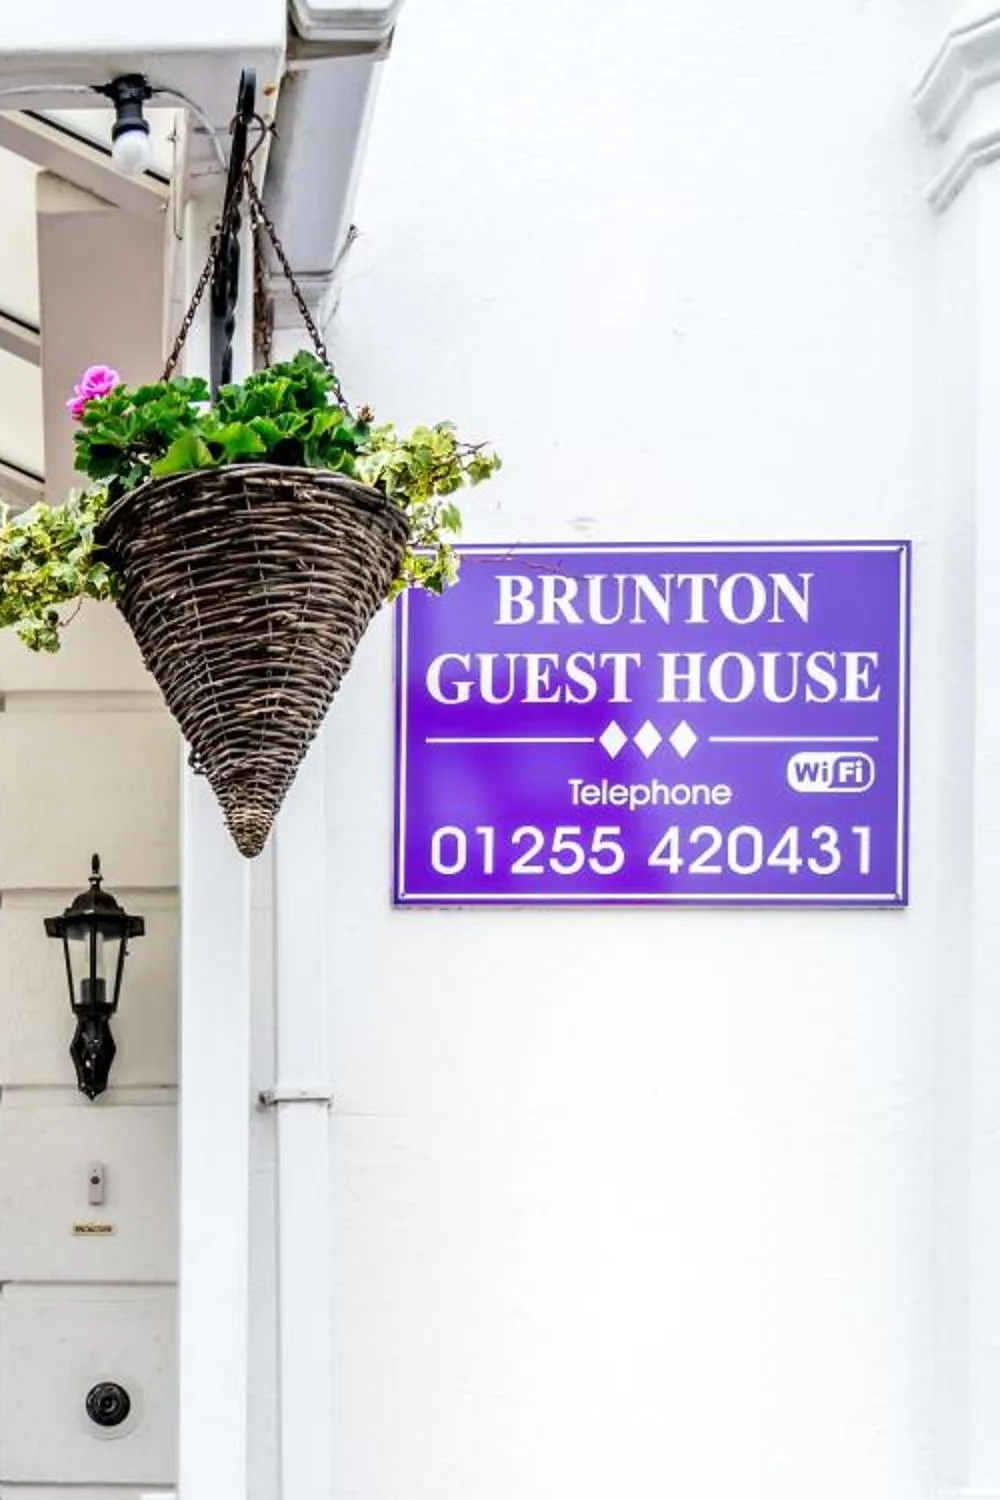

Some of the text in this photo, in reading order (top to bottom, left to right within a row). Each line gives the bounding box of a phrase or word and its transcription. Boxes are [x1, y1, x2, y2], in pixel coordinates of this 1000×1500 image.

[494, 573, 814, 624] BRUNTON
[426, 652, 881, 704] GUEST HOUSE
[569, 779, 733, 810] Telephone
[792, 758, 867, 786] WiFi
[430, 825, 871, 875] 01255 420431
